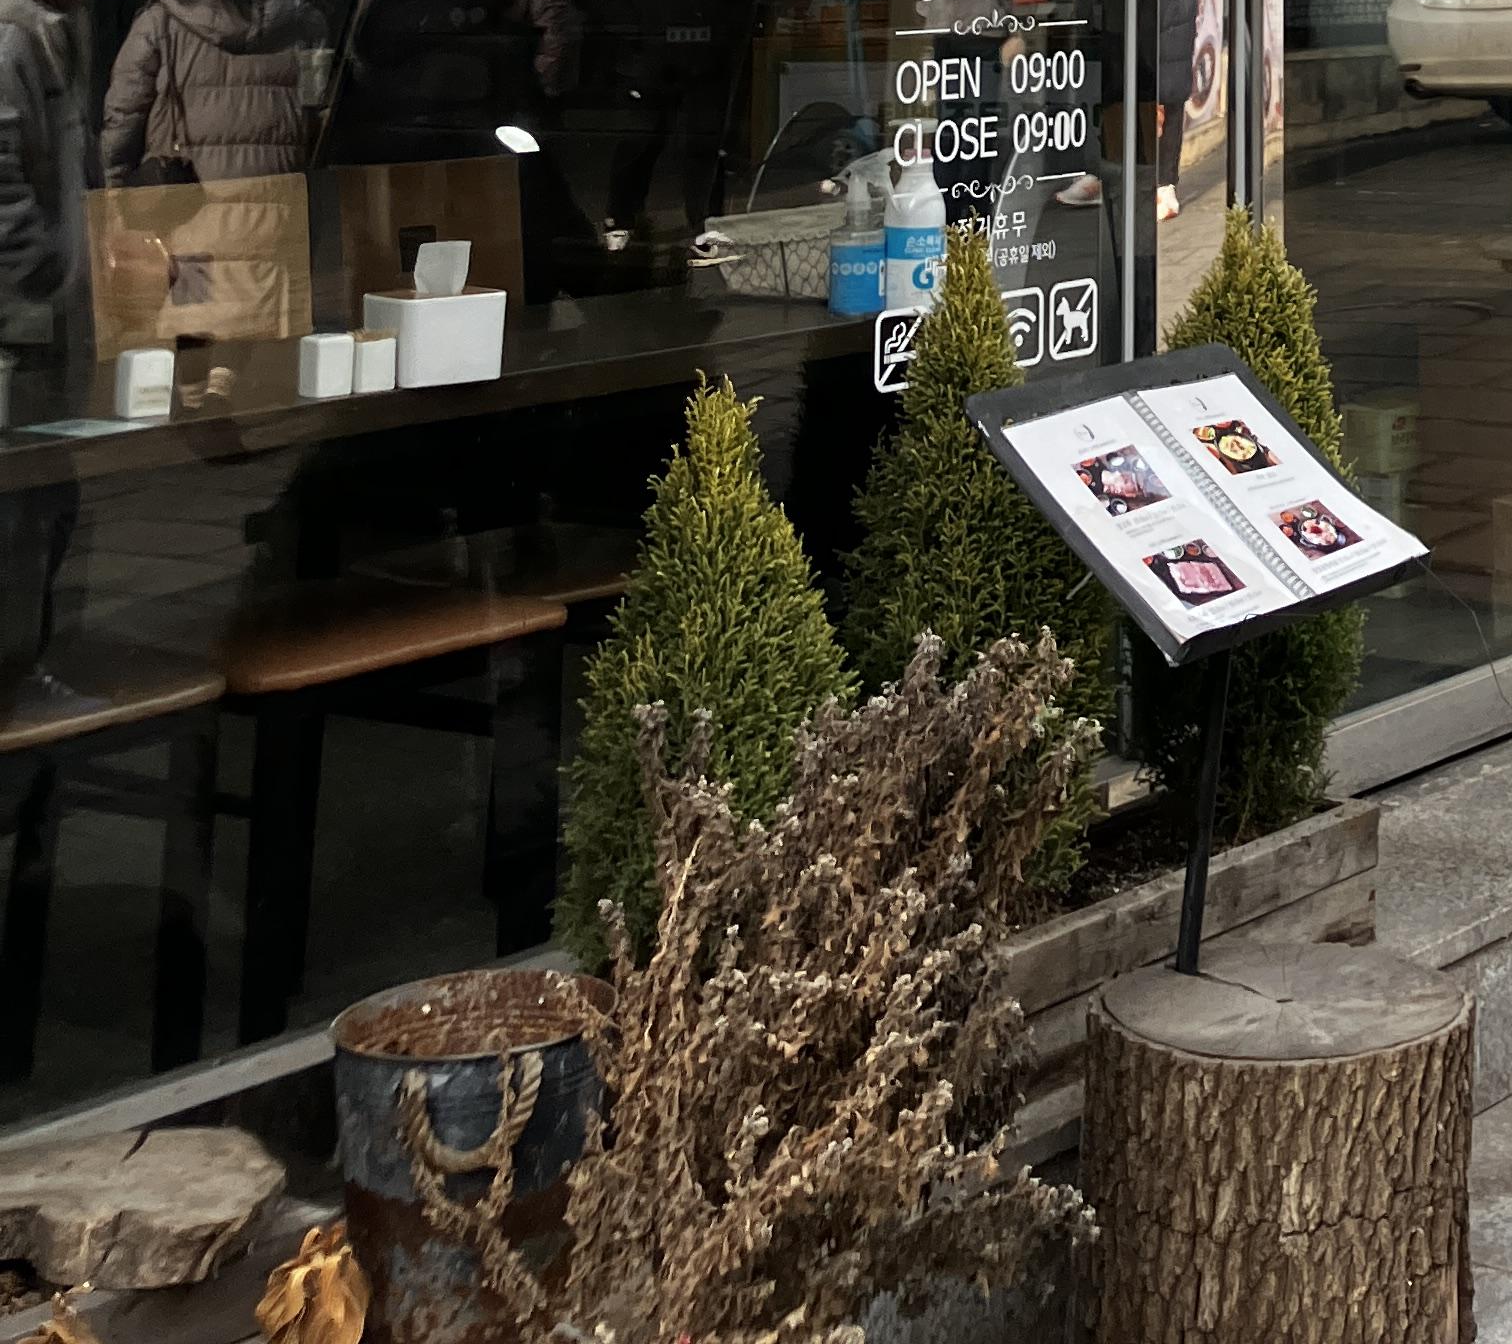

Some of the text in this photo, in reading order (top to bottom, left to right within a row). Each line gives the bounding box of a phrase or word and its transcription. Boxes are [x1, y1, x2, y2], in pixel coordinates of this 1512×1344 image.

[895, 49, 1086, 104] OPEN 09:00
[893, 108, 1087, 167] CLOSE 09:00
